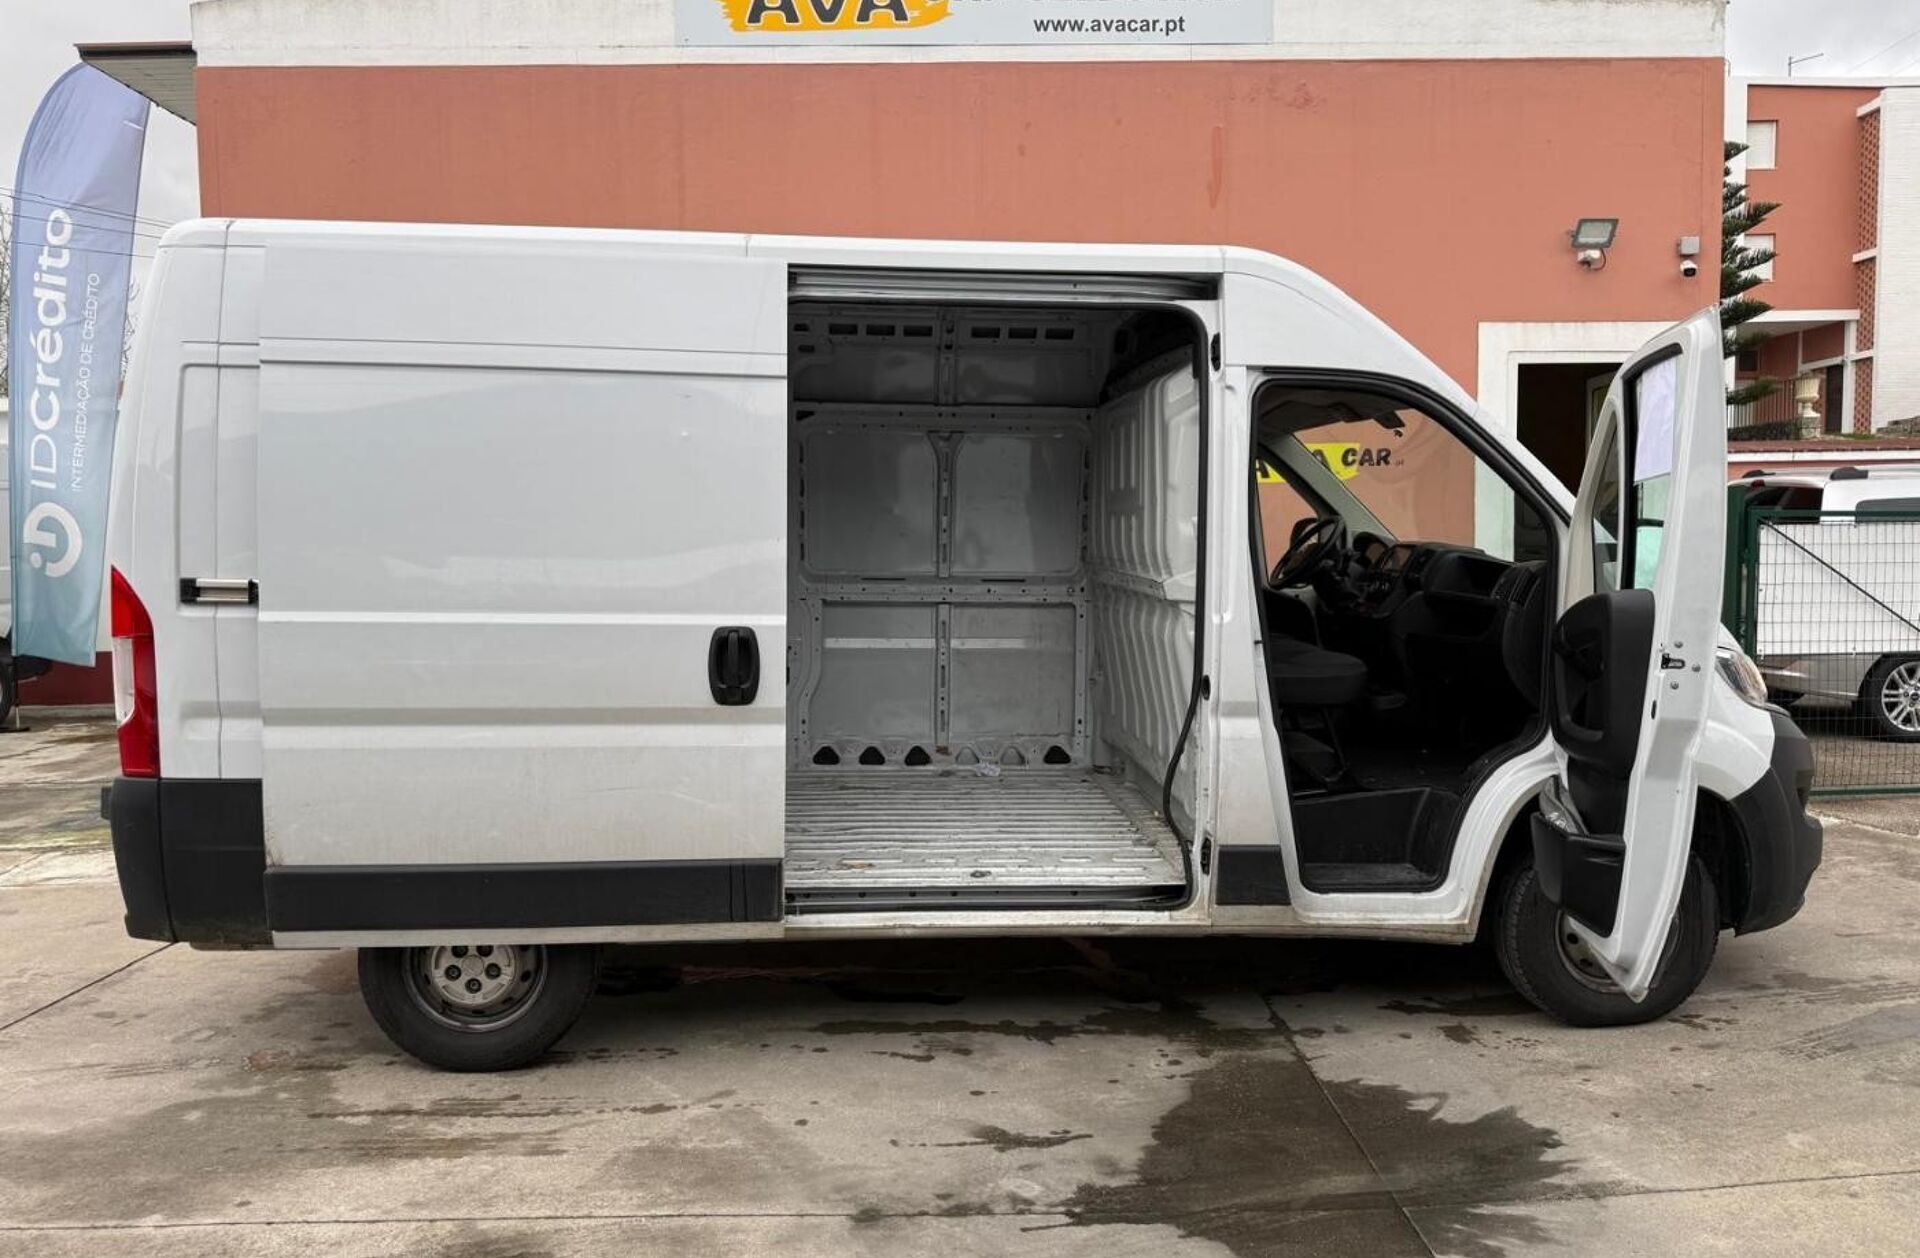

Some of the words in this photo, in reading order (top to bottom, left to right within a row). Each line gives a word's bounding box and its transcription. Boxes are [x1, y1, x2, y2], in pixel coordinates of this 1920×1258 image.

[1033, 16, 1186, 36] www.avacar.pt
[82, 272, 101, 339] CRÉDITO
[30, 208, 73, 490] IDCrédito
[80, 342, 94, 365] DE
[70, 367, 91, 493] INTERMEDIAÇÃO
[1341, 448, 1391, 466] CAR
